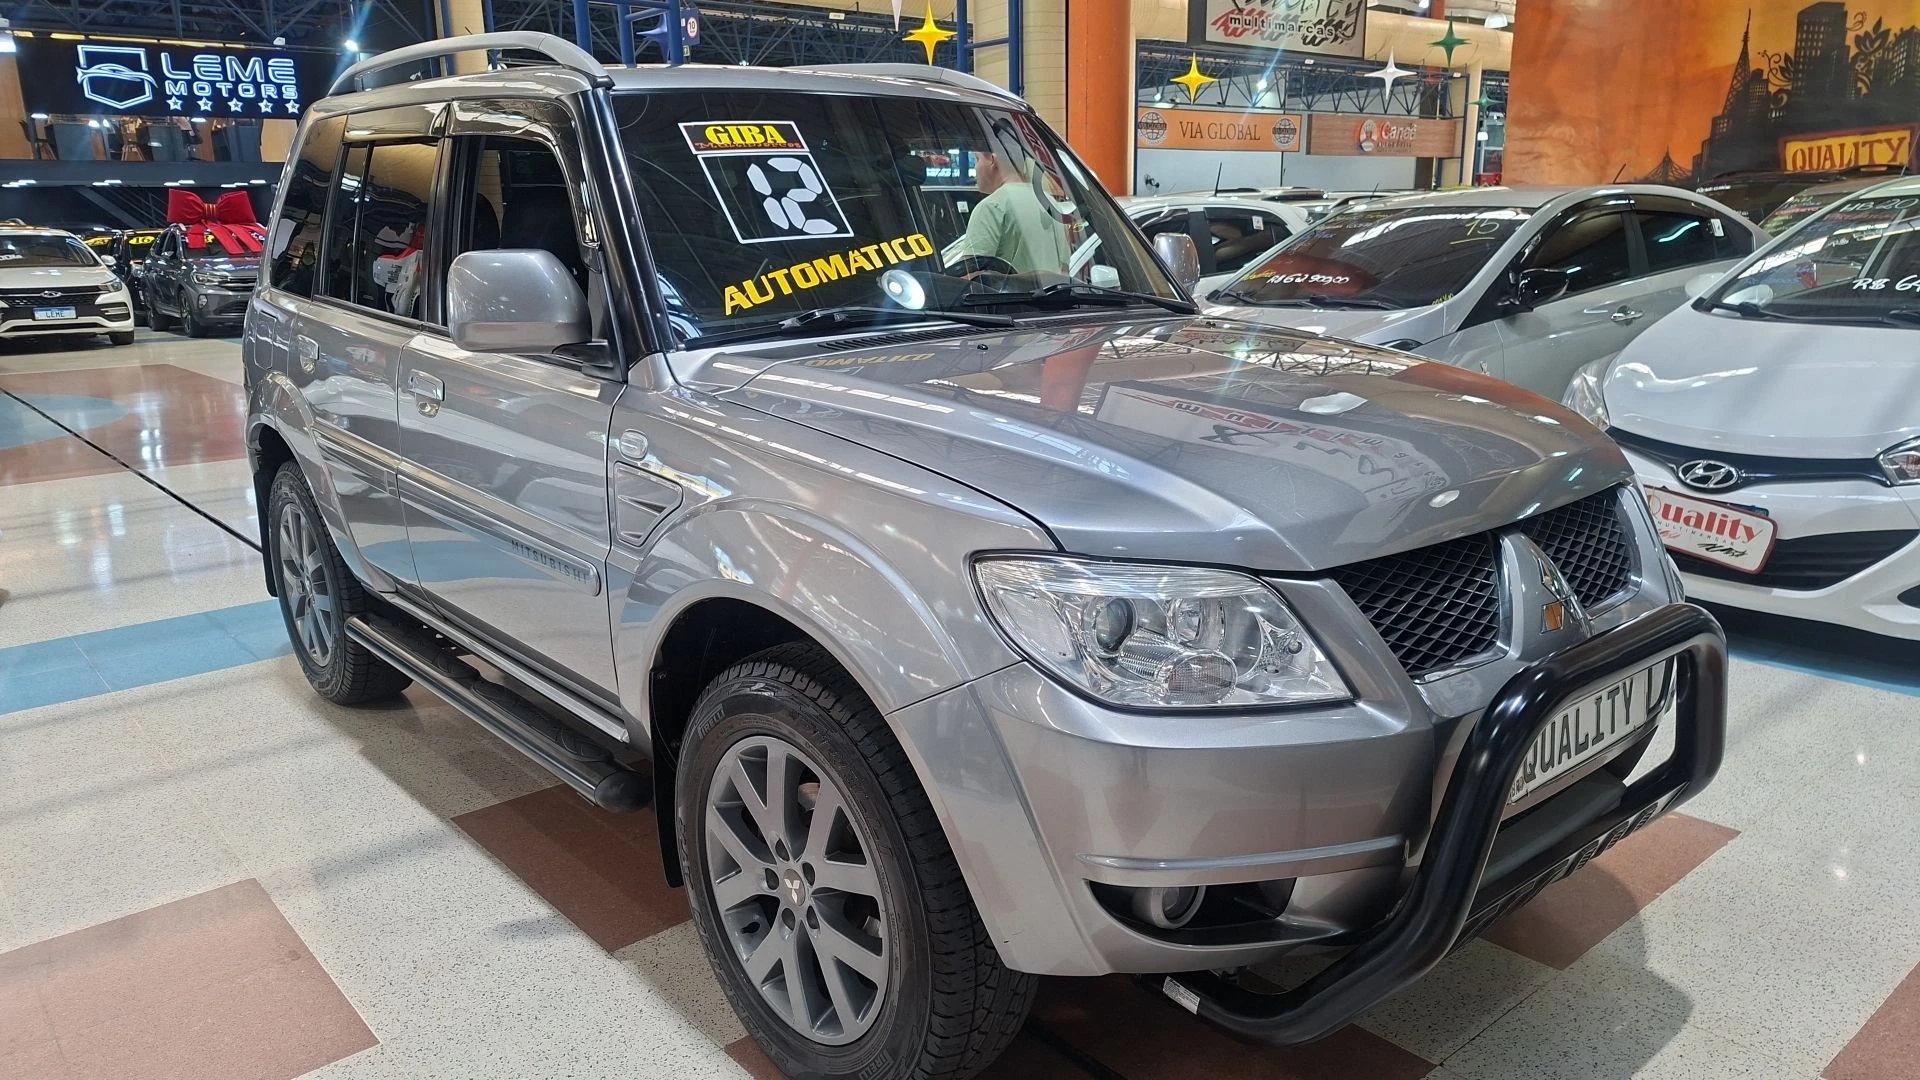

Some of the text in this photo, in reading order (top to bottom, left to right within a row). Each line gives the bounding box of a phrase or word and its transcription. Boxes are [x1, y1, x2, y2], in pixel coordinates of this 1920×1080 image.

[1229, 14, 1334, 37] multimarcas
[161, 52, 296, 84] LEME
[164, 80, 298, 100] MOTORS
[705, 125, 787, 145] GIBA
[1179, 121, 1203, 139] VIA
[1207, 122, 1260, 141] GLOBAL
[1791, 137, 1907, 171] QUALITY
[746, 157, 838, 234] 12
[1465, 217, 1500, 236] 15
[511, 540, 587, 584] MITSUBISHI
[1522, 677, 1634, 783] QUALITY
